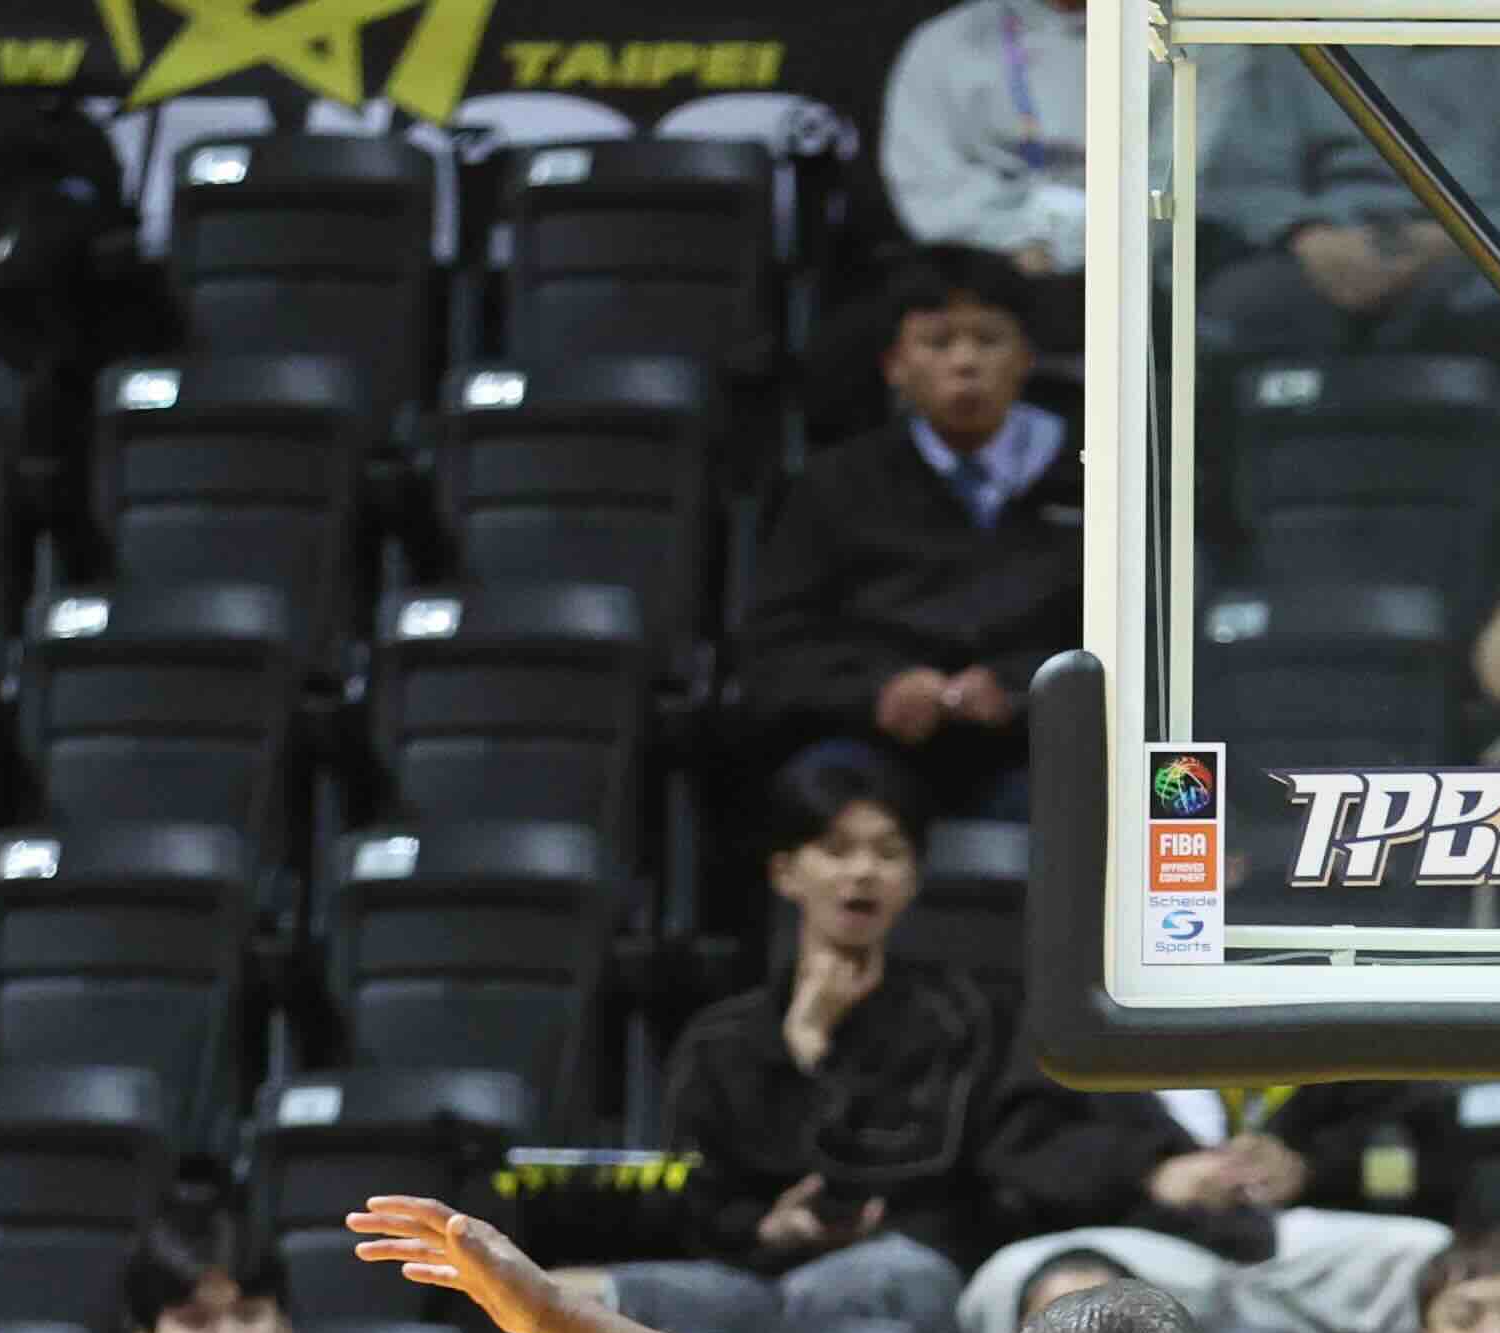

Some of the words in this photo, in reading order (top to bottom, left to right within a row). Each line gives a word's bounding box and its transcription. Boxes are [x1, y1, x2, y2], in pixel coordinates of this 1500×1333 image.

[502, 40, 784, 90] TAIPEI
[1158, 832, 1208, 857] FIBA
[1155, 942, 1212, 954] Sports
